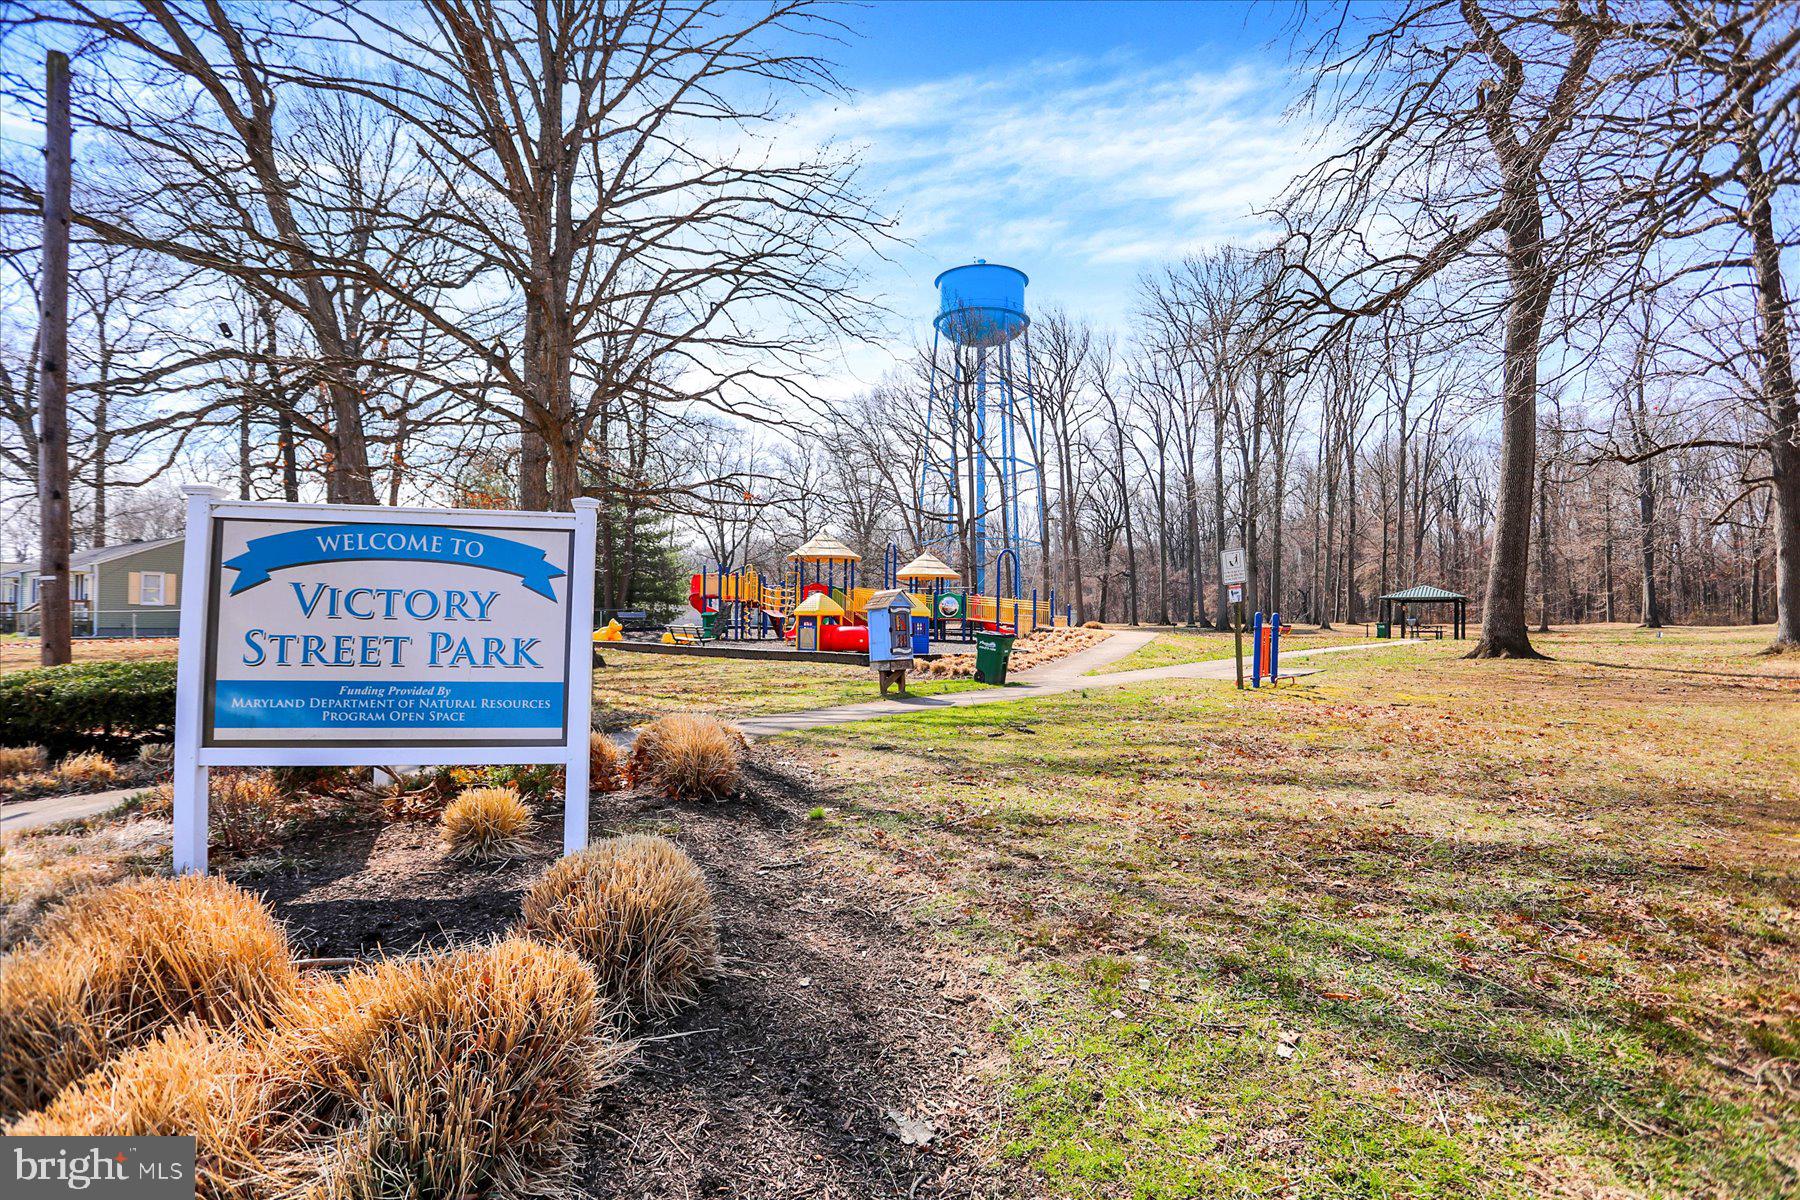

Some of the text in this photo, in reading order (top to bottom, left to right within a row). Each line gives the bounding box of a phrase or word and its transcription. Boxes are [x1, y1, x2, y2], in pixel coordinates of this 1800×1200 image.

[316, 533, 484, 558] WELCOME TO
[289, 582, 500, 621] VICTORY
[242, 628, 544, 669] STREET PARK
[339, 685, 451, 698] Funding Provided By
[231, 697, 551, 709] MARYLAND DEPARTMENT OF NATURAL RESOURCES
[322, 710, 466, 722] PROGRAM OPEN SPACE
